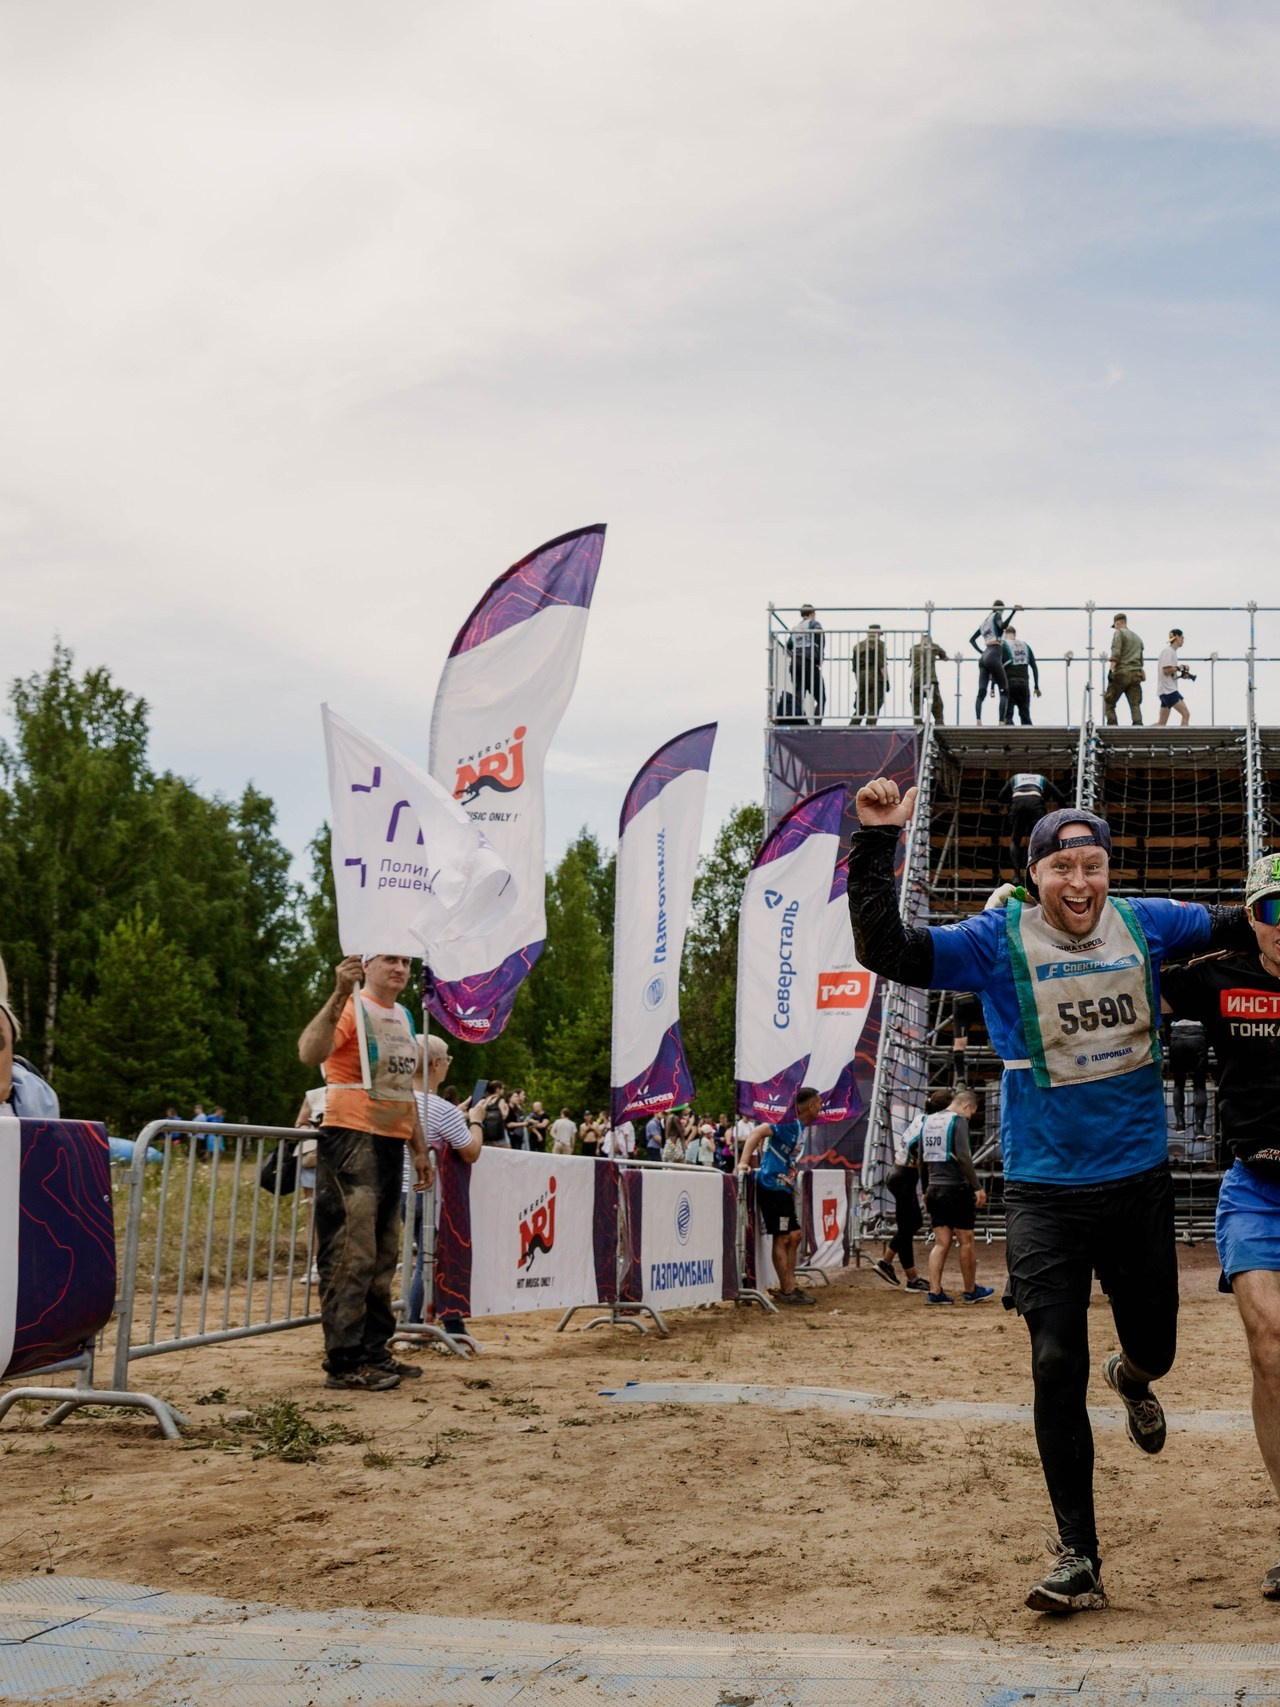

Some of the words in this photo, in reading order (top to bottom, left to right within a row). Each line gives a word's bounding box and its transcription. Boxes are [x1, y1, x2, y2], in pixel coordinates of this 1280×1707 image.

[458, 737, 511, 765] ENERGY
[489, 812, 511, 822] ONLY
[377, 876, 437, 896] решен
[773, 900, 800, 1029] Северсталь
[1057, 993, 1138, 1036] 5590
[388, 1055, 416, 1074] 5567
[1091, 1047, 1133, 1062] ГАЗПРОМБАНК
[650, 1258, 714, 1291] ГАЗПРОМБАНК
